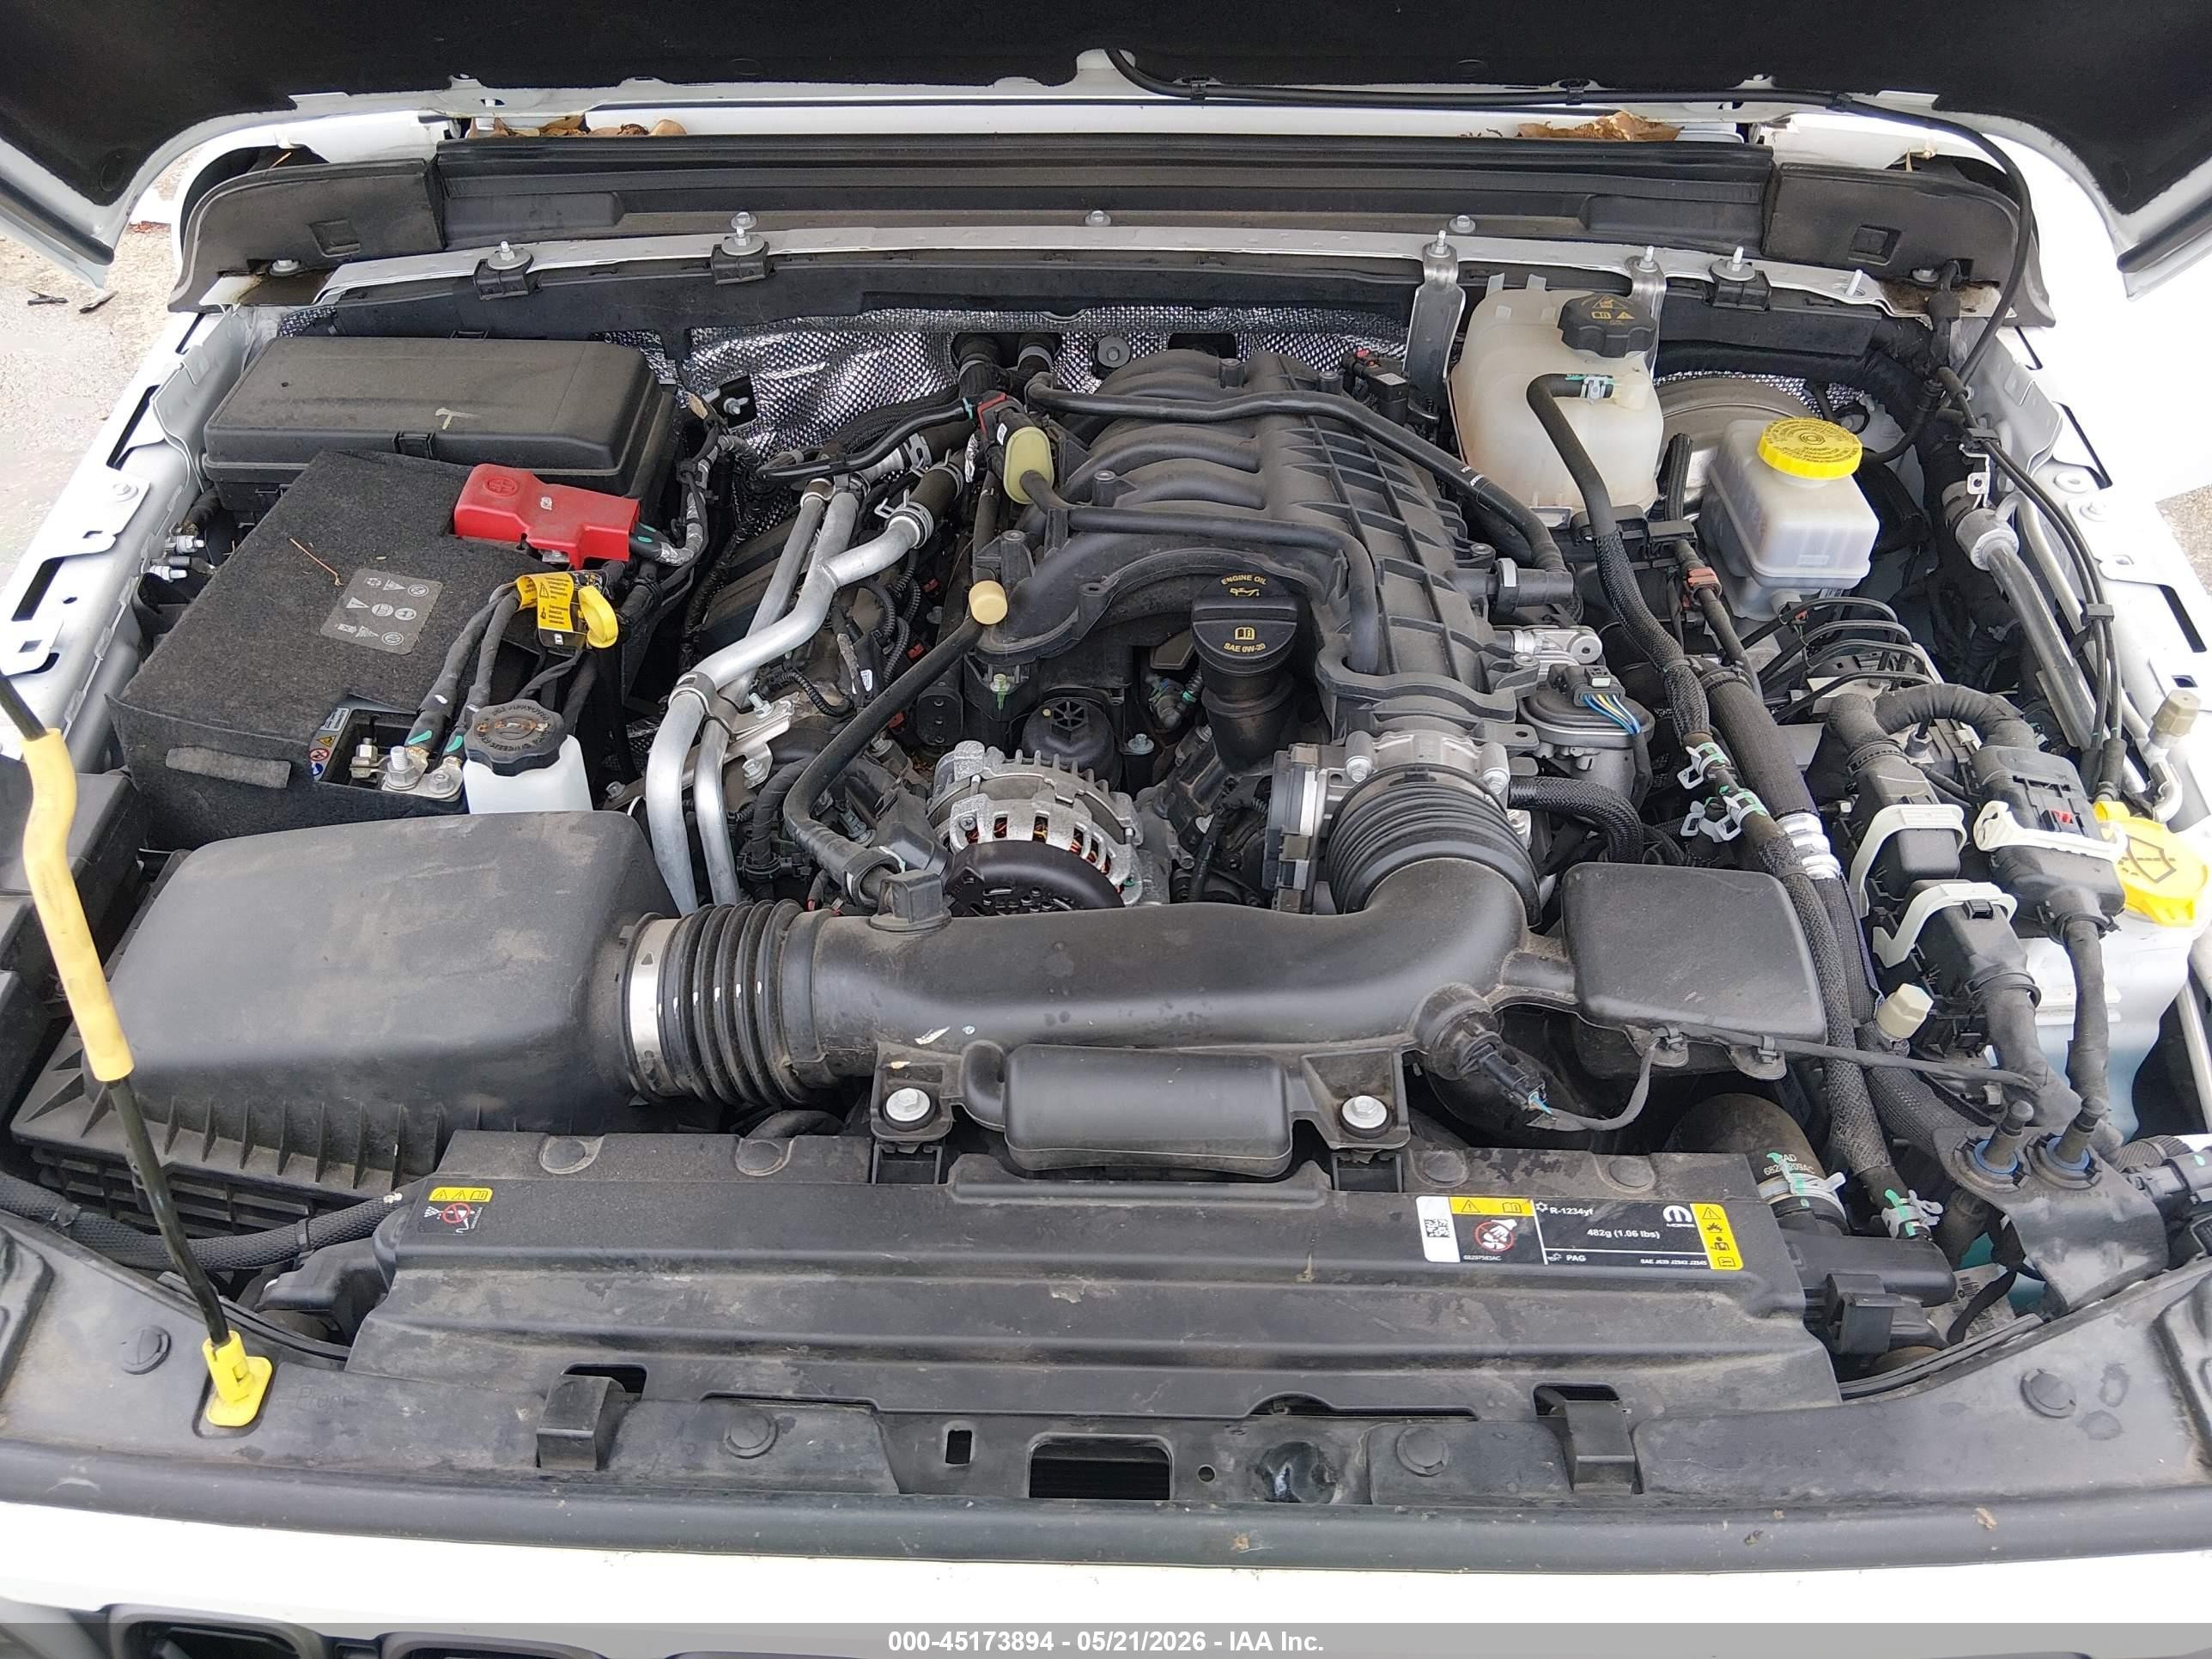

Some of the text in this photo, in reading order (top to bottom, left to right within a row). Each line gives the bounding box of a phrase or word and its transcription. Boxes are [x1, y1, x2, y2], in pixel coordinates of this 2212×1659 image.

[1221, 574, 1268, 585] ENGINE OIL
[1224, 642, 1266, 653] SAE 0W-20
[1549, 1206, 1594, 1216] R-1234yf
[1587, 1229, 1660, 1239] 482g (1.06 lbs)
[1566, 1254, 1587, 1262] PAG
